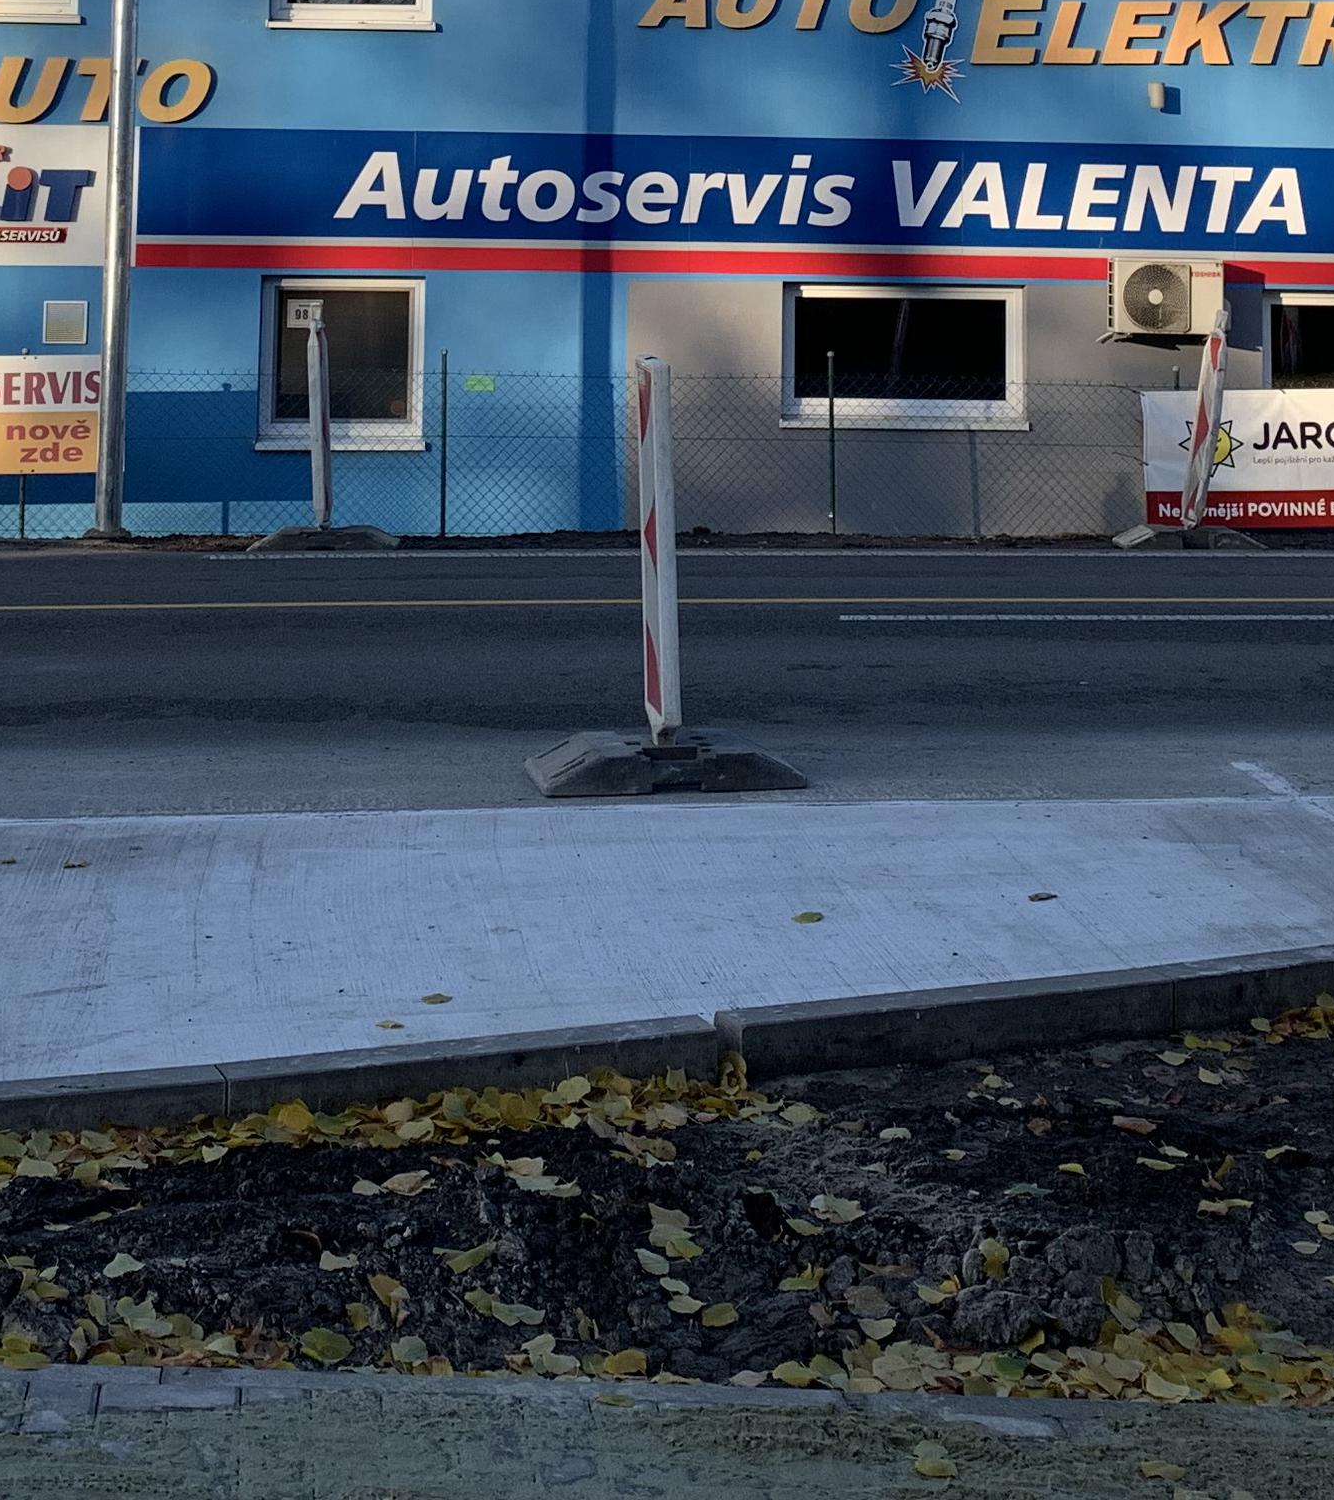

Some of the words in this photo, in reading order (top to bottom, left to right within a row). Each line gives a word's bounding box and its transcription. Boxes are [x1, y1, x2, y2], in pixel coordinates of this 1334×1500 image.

[333, 151, 855, 227] Autoservis
[892, 160, 1308, 235] VALENTA
[5, 419, 92, 441] nově
[19, 442, 84, 464] zde
[1308, 456, 1322, 465] pro
[1248, 498, 1327, 517] POVINNÉ
